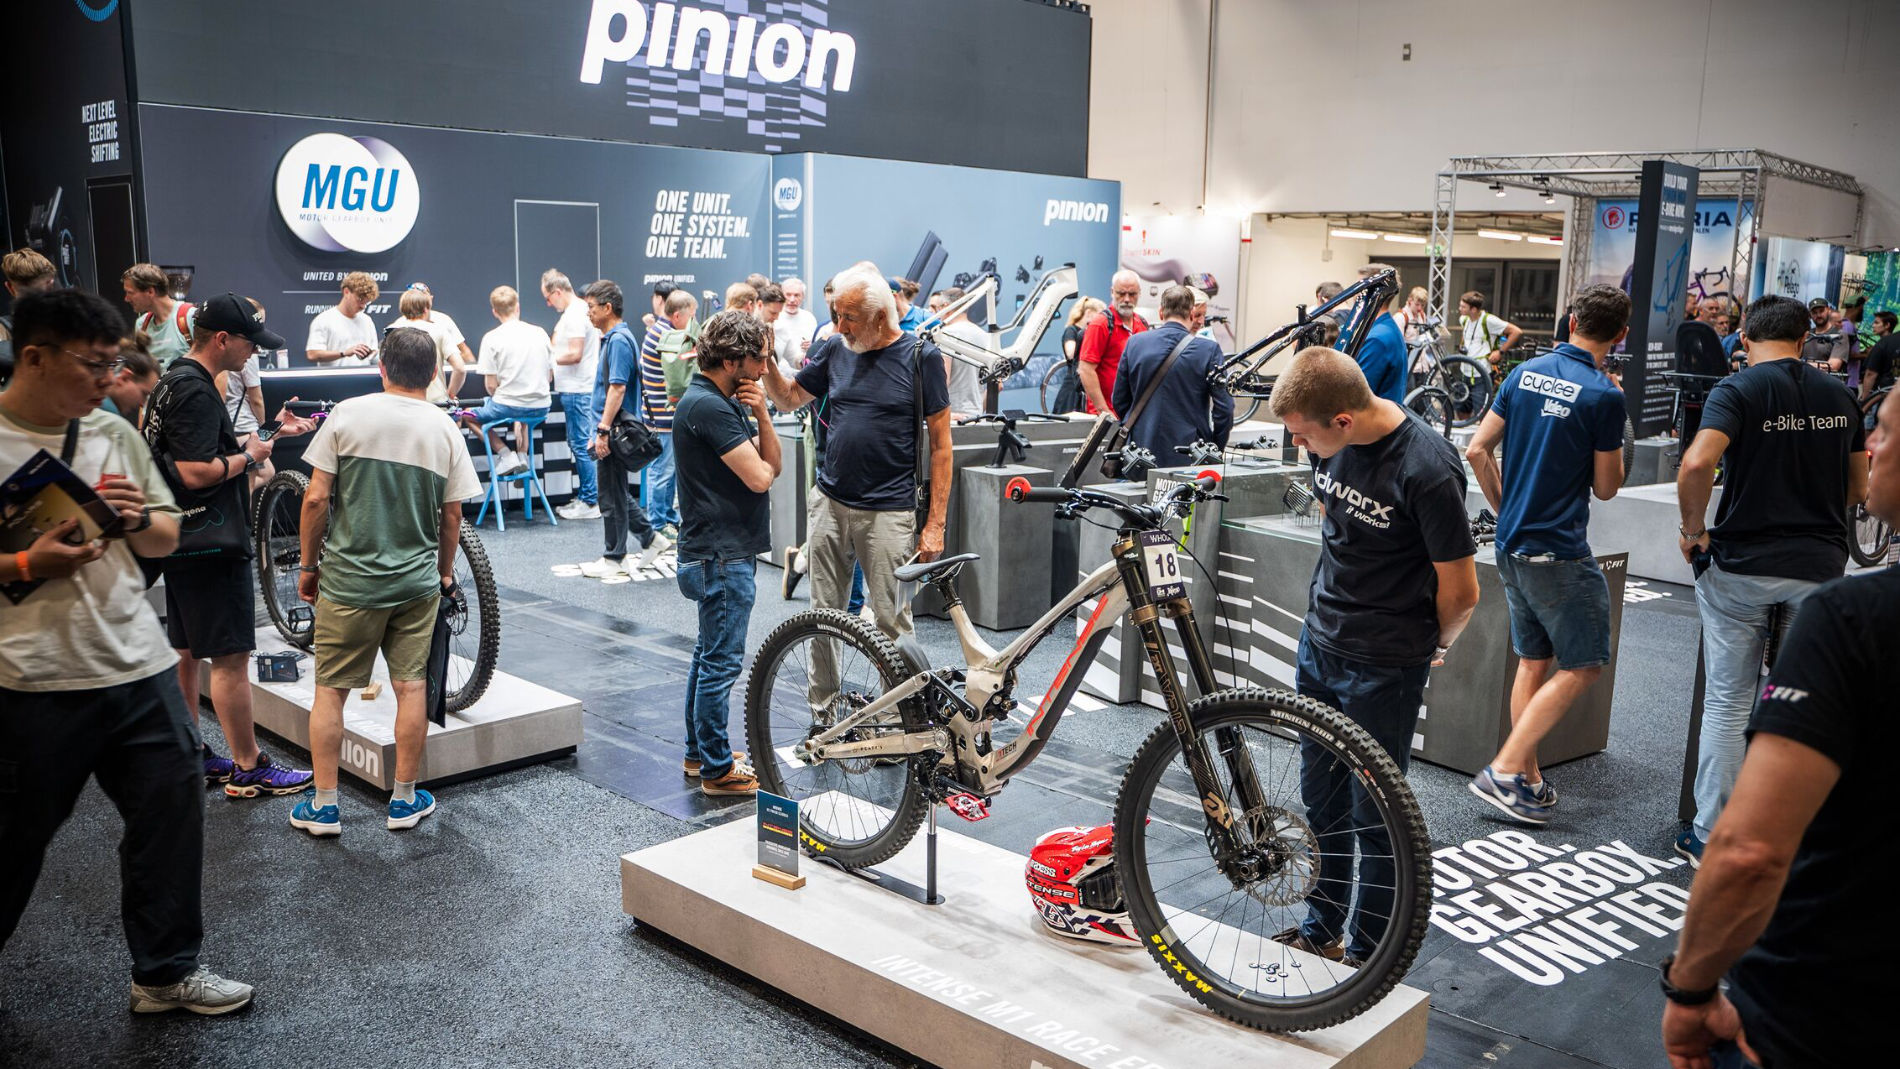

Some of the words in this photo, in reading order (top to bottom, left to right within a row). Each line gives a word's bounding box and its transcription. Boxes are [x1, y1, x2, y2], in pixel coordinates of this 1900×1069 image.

[580, 0, 856, 92] pinion
[82, 103, 97, 123] NEXT
[89, 121, 118, 143] ELECTRIC
[92, 141, 119, 163] SHIFTING
[302, 164, 399, 212] MGU
[779, 187, 797, 200] MGU
[656, 190, 689, 212] ONE
[692, 192, 731, 214] UNIT.
[1044, 199, 1109, 226] pinion
[651, 213, 684, 235] ONE
[687, 215, 750, 237] SYSTEM.
[645, 236, 679, 258] ONE
[683, 237, 727, 258] TEAM.
[303, 272, 334, 281] UNITED
[337, 272, 349, 281] BY
[367, 305, 391, 313] FIT
[1523, 375, 1575, 397] cyclee
[1763, 414, 1806, 432] e-Bike
[1808, 415, 1848, 430] Team
[1315, 466, 1394, 520] idworx
[1345, 505, 1355, 514] it
[1354, 511, 1391, 529] works!
[1155, 552, 1176, 578] 18
[1026, 592, 1109, 737] INTENSE
[1771, 686, 1809, 702] FIT
[1270, 709, 1311, 728] MINION
[1432, 831, 1577, 898] OTOR.
[1430, 840, 1687, 943] GEARBOX.
[1151, 934, 1213, 993] MAXXIS
[872, 954, 993, 1005] INTENSE
[1024, 1020, 1120, 1061] RACE
